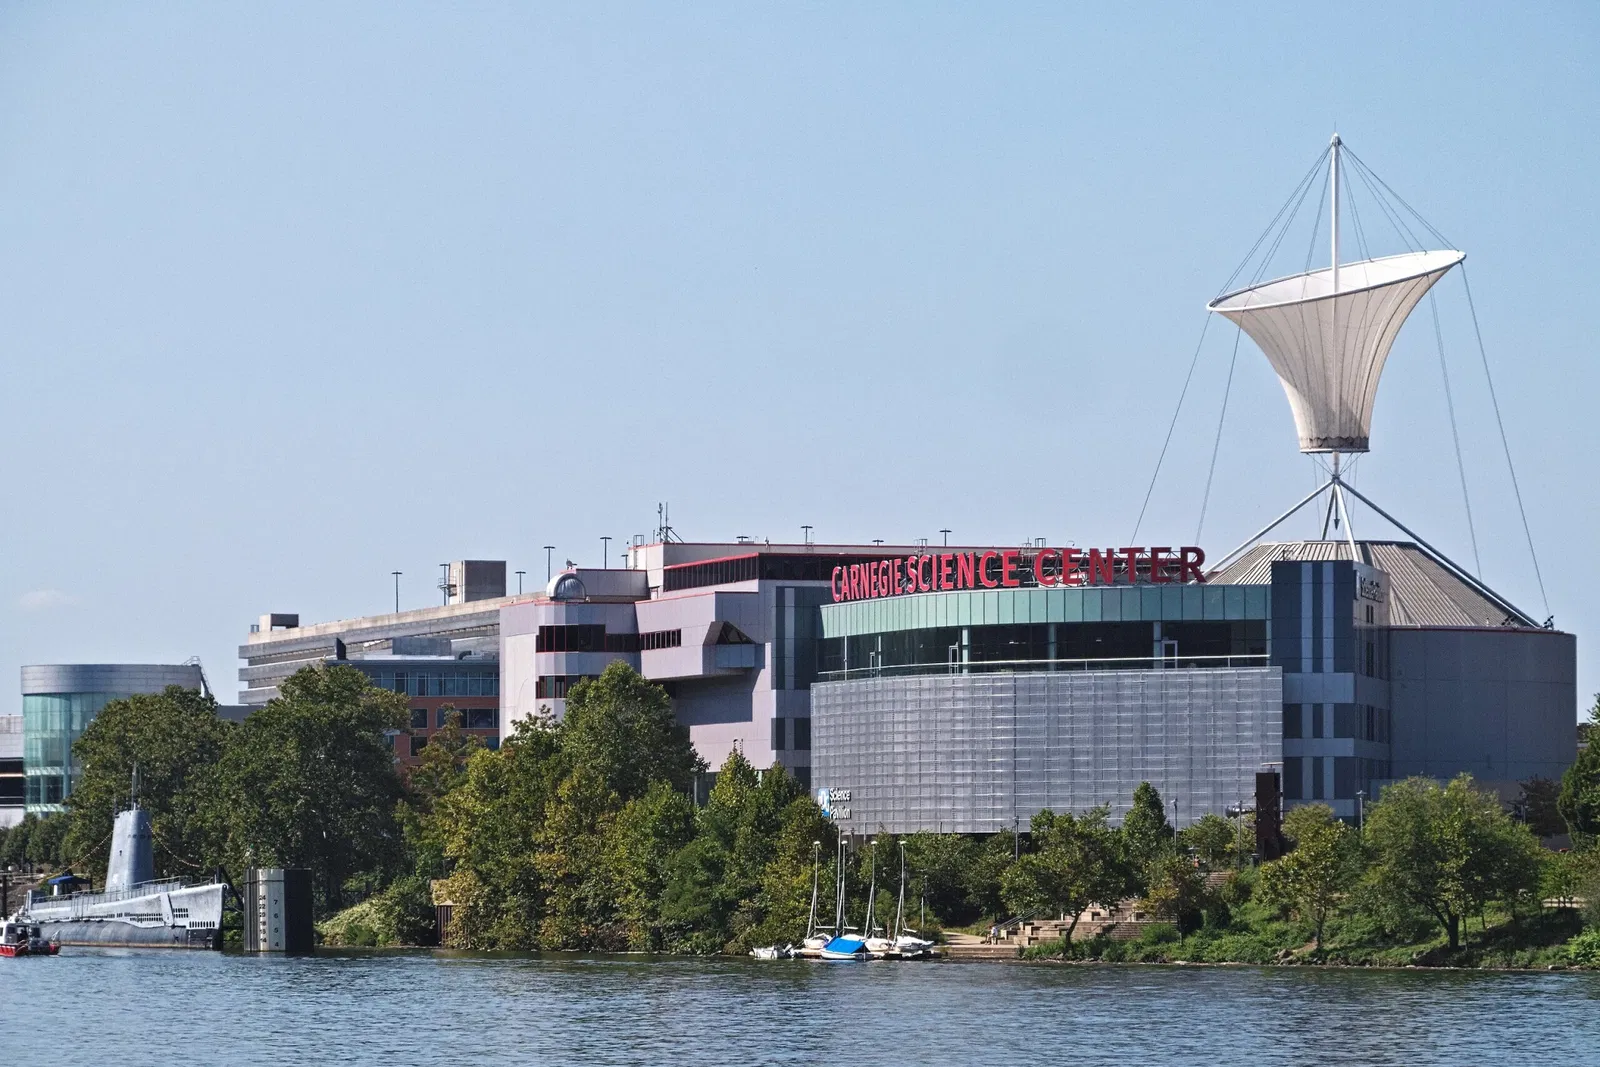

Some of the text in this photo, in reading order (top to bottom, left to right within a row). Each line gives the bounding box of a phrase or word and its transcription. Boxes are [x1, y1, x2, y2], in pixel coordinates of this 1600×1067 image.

[831, 546, 1207, 603] CARNEGIE SCIENCE CENTER
[830, 787, 851, 801] Science
